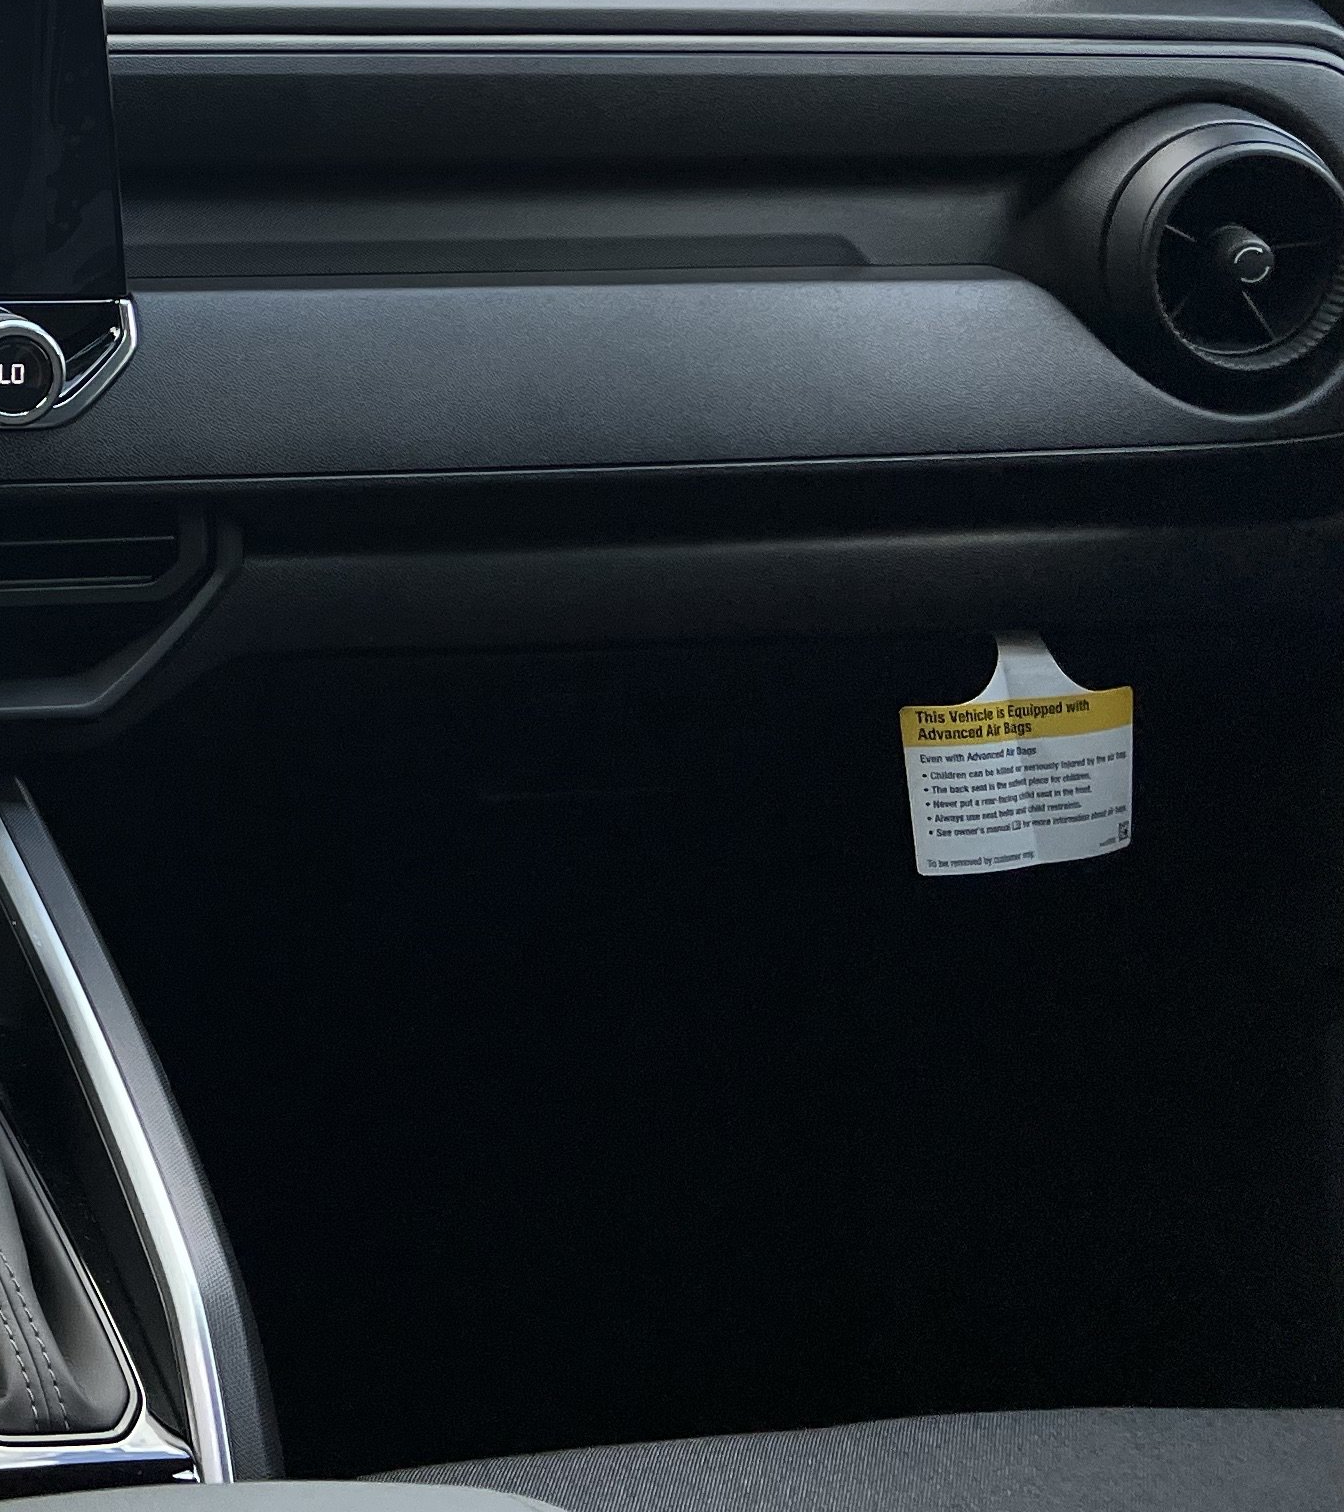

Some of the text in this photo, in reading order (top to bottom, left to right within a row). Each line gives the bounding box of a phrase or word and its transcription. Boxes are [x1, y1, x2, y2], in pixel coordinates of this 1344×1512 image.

[915, 699, 1090, 724] This Vehicle is Equipped with
[917, 721, 1032, 741] Advanced Air Bags
[920, 754, 943, 763] Even
[945, 753, 965, 762] with
[967, 749, 1004, 761] Advanced
[930, 771, 966, 779] Children
[969, 770, 983, 778] can
[985, 769, 994, 777] be
[932, 785, 947, 794] The
[949, 785, 969, 793] back
[936, 829, 952, 837] See
